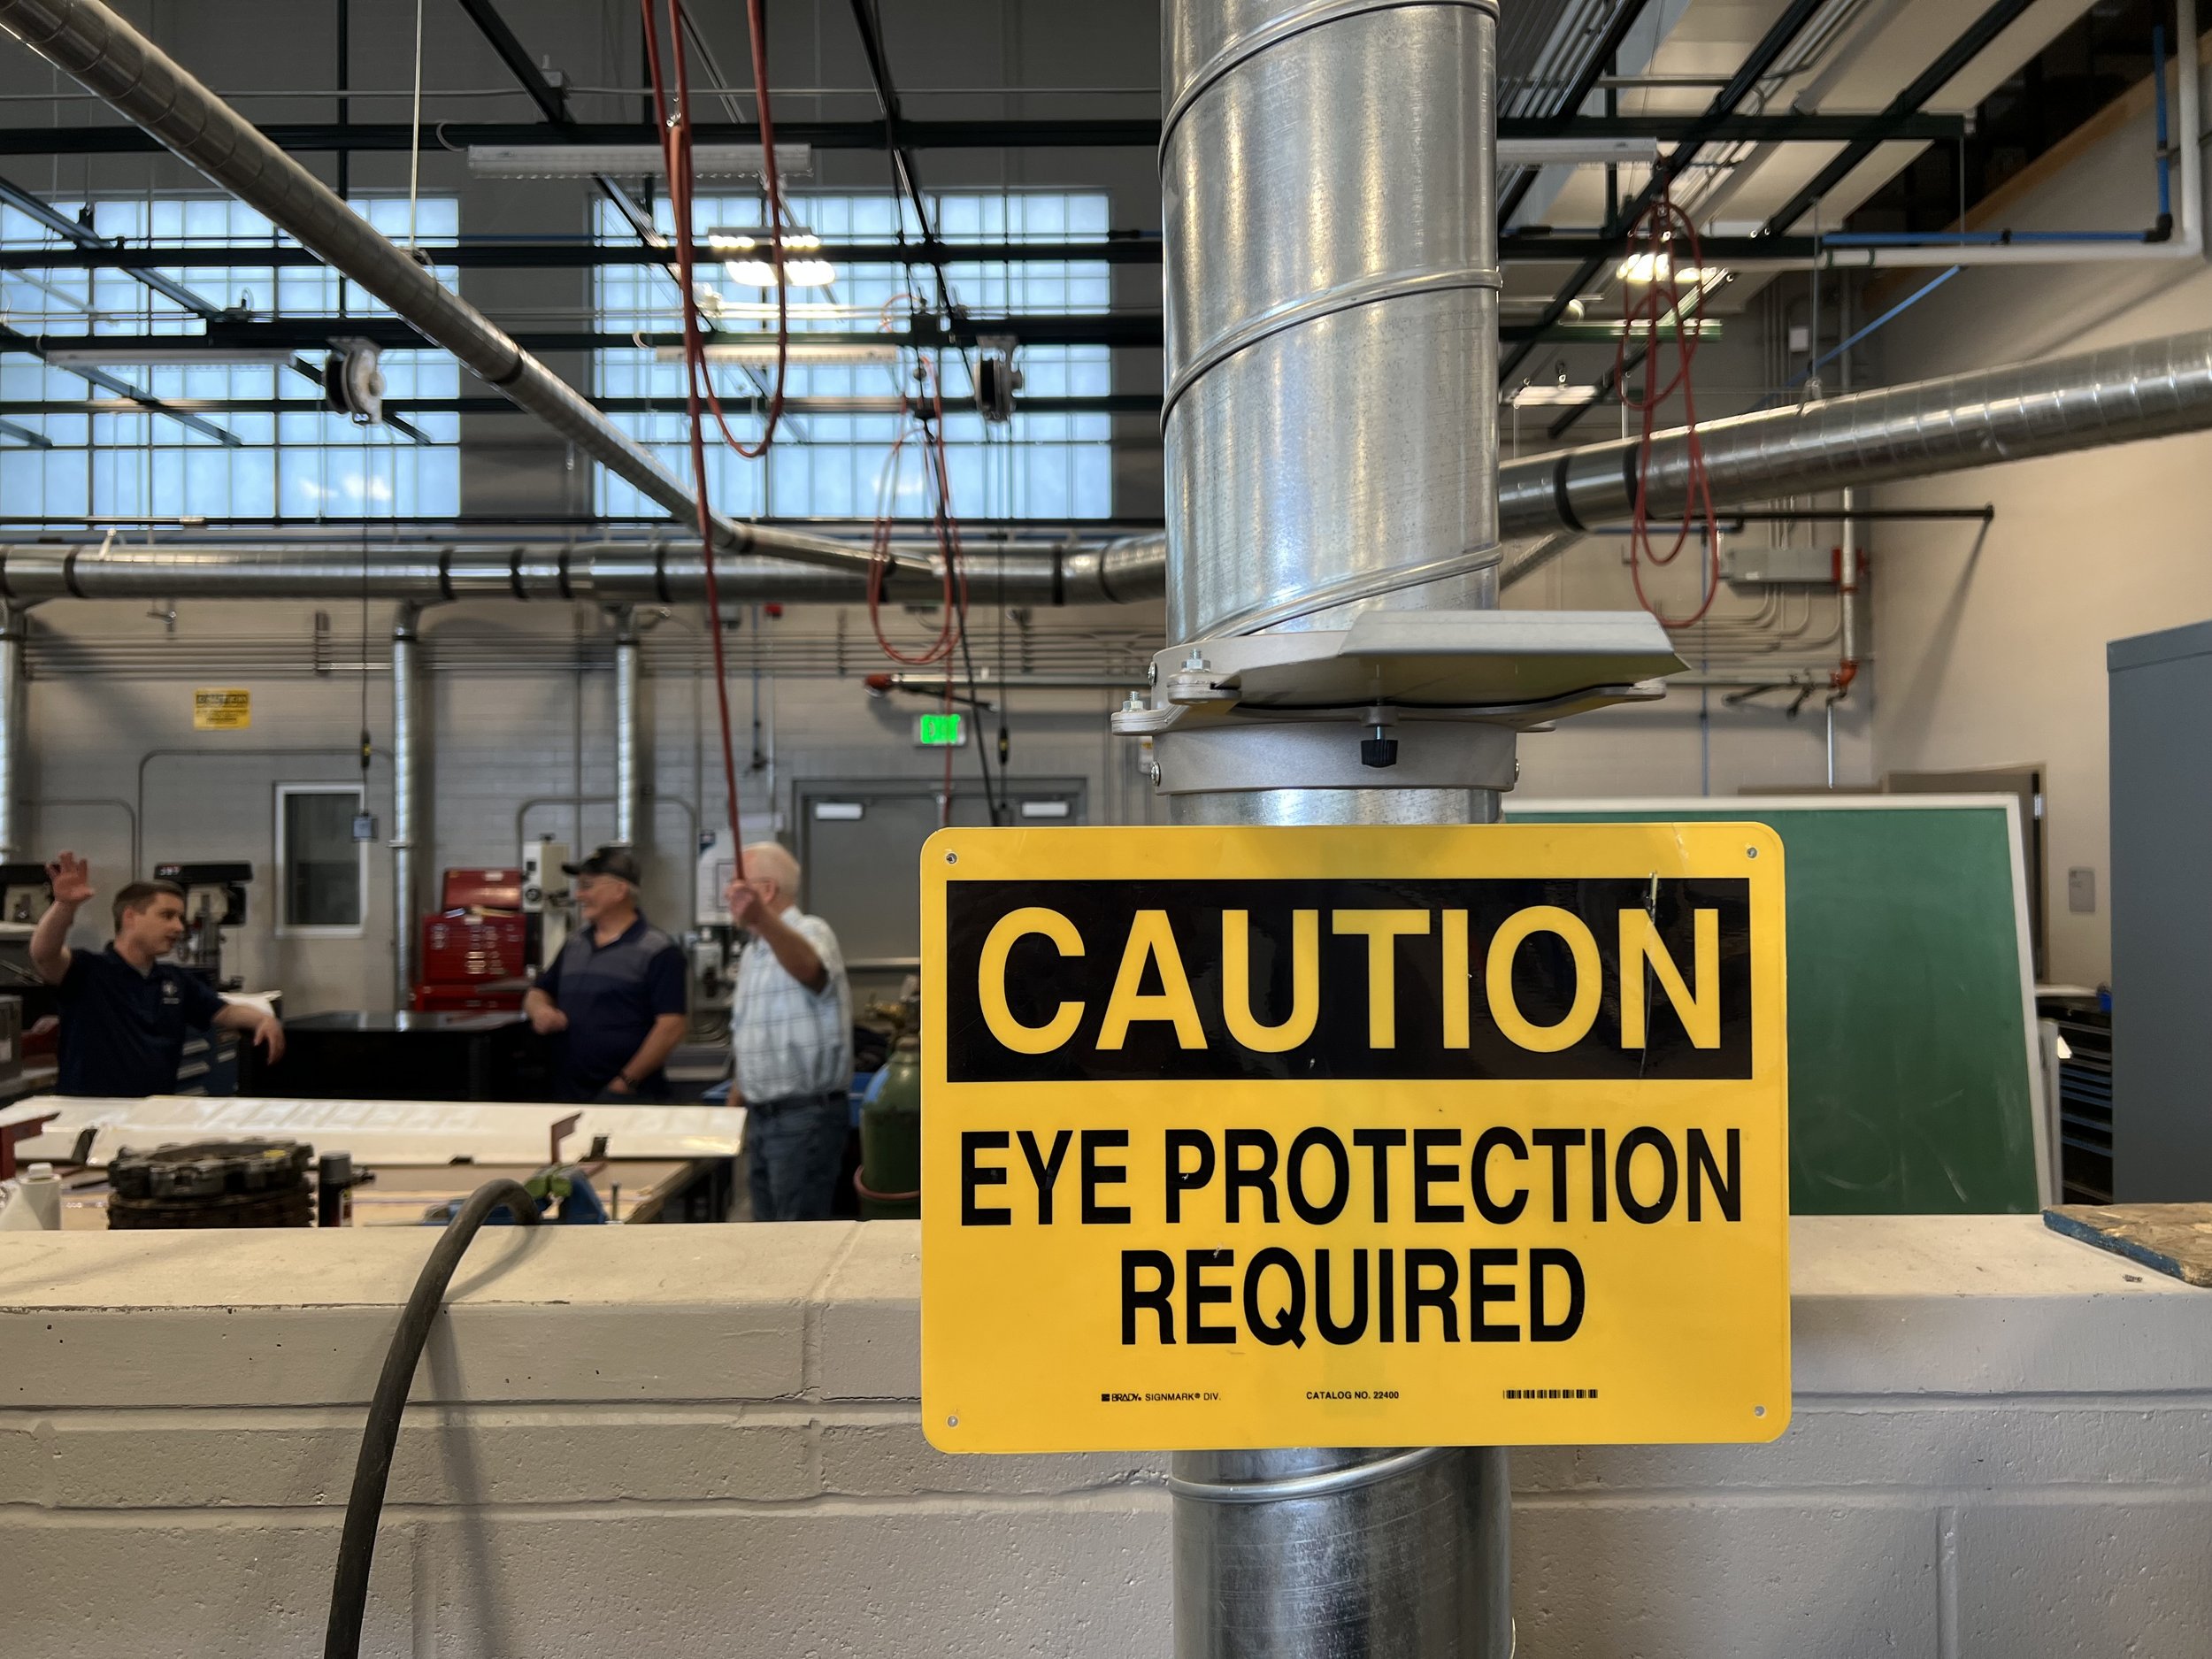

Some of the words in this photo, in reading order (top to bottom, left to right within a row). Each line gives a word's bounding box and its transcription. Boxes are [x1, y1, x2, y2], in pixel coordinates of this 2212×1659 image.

[978, 905, 1722, 1055] CAUTION
[962, 1129, 1131, 1226] EYE
[1165, 1126, 1741, 1226] PROTECTION
[1122, 1247, 1586, 1349] REQUIRED
[1306, 1391, 1352, 1400] CATALOG
[1355, 1391, 1371, 1400] NO.
[1373, 1391, 1400, 1400] 22400
